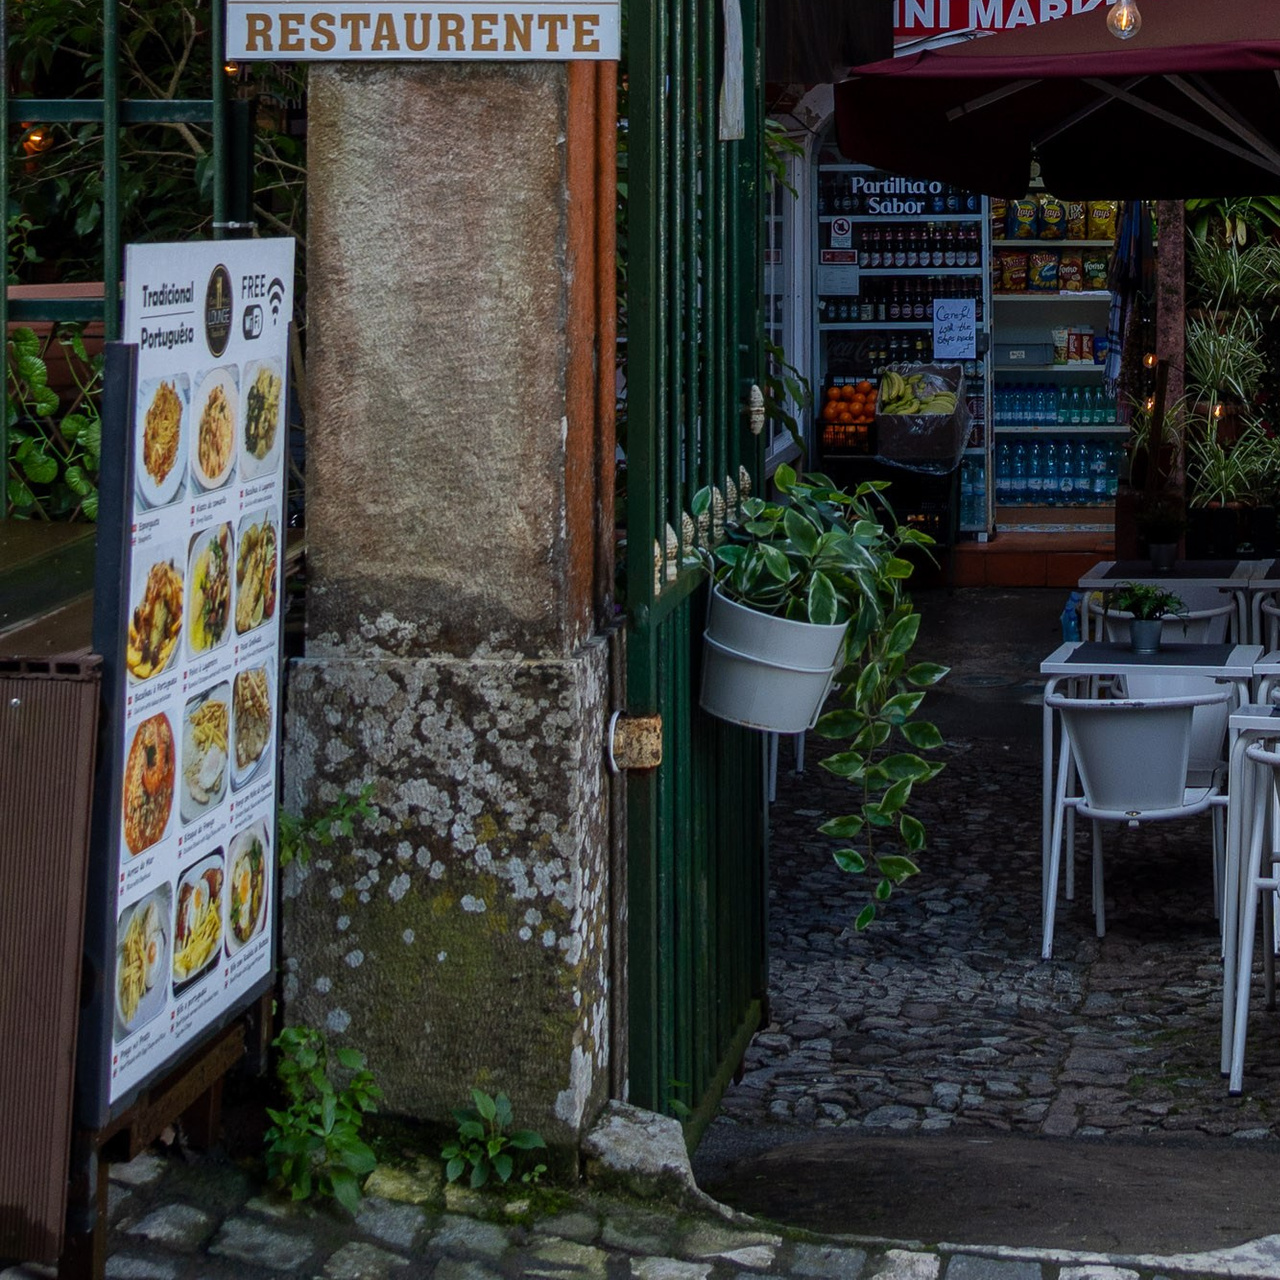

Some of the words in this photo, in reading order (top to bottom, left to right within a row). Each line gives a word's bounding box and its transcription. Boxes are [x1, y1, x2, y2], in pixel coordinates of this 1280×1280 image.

[245, 13, 601, 52] RESTAURENTE
[850, 176, 928, 195] Partilha
[928, 180, 943, 194] o
[868, 196, 926, 214] Sabor
[142, 281, 195, 308] Tradicional
[241, 274, 266, 299] FREE
